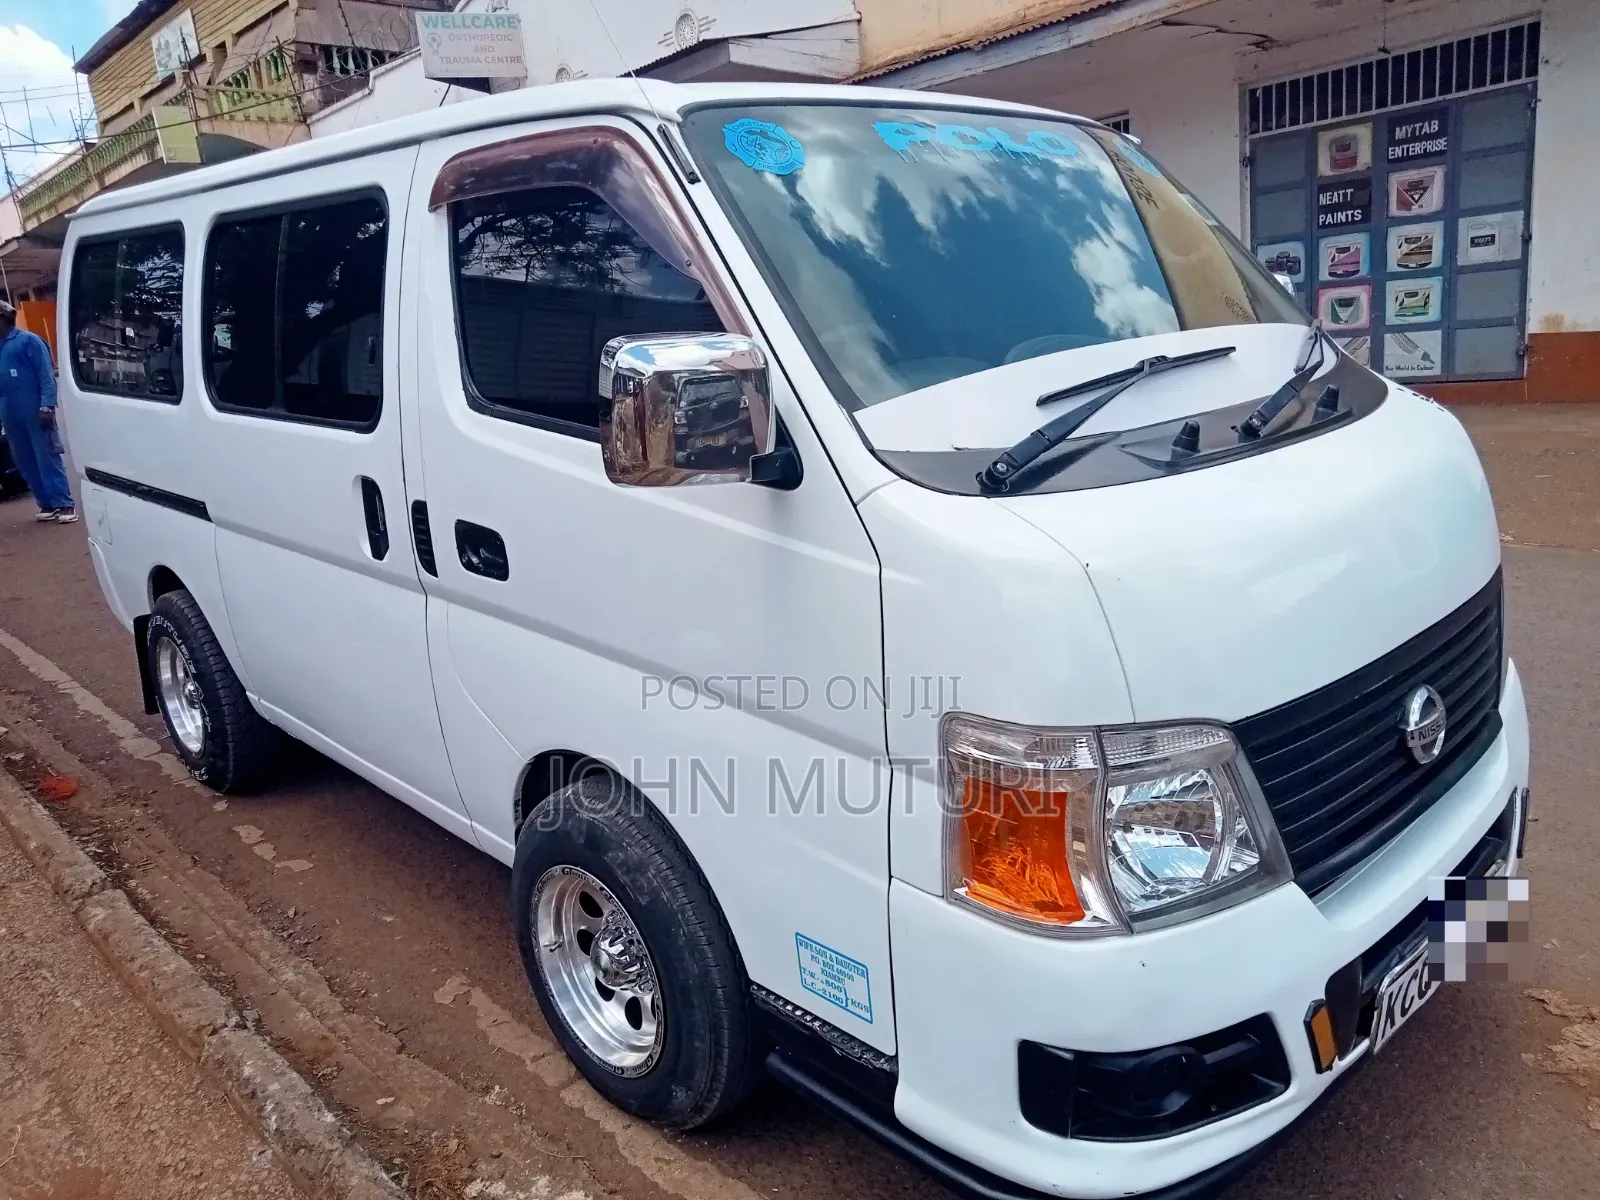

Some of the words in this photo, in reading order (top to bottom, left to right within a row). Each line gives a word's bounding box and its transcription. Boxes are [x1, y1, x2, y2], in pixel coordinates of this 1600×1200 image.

[422, 15, 518, 29] WELLCARE
[448, 33, 514, 42] ORTHOPEDIC
[473, 45, 495, 53] AND
[439, 56, 482, 65] TRAUMA
[484, 55, 523, 64] CENTRE
[732, 121, 771, 130] CHRISTIAN
[1395, 120, 1439, 140] MYTAB
[871, 121, 1079, 161] POLO
[1388, 137, 1448, 159] ENTERPRISE
[1319, 188, 1354, 206] NEATT
[1319, 209, 1362, 226] PAINTS
[1418, 716, 1445, 742] NISS
[798, 938, 814, 953] WIFE
[814, 946, 828, 960] SON
[829, 953, 835, 962] &
[822, 958, 836, 974] BOX
[820, 967, 846, 986] KIAMBU
[851, 998, 870, 1014] KGS
